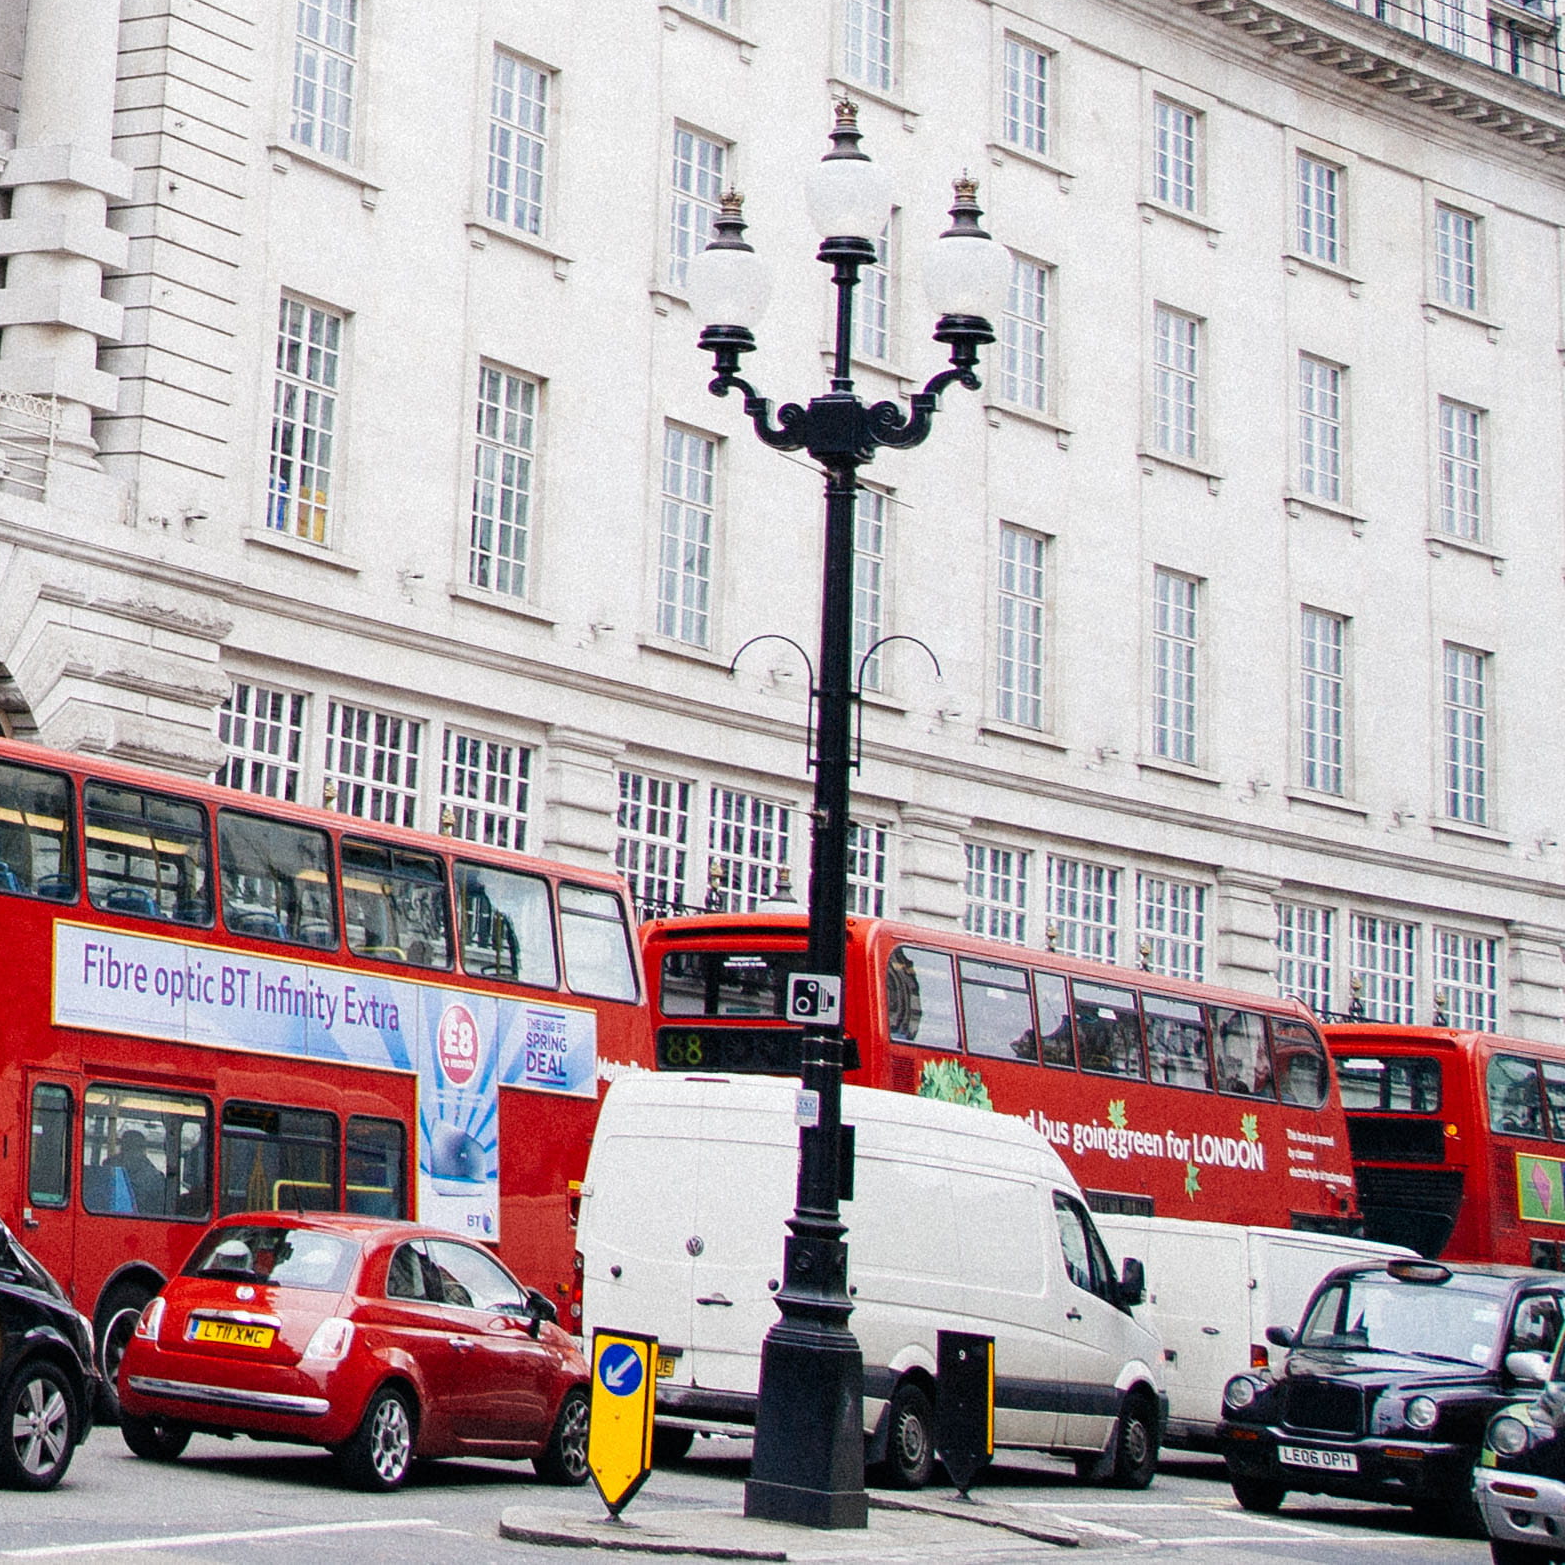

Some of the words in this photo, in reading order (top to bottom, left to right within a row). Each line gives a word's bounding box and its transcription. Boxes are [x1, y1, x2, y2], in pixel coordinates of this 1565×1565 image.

[84, 943, 148, 993] Fibre
[154, 961, 214, 1007] optic
[221, 966, 251, 1008] BT
[256, 971, 338, 1030] Infinity
[344, 985, 399, 1031] Extra
[526, 1017, 541, 1030] THE
[542, 1019, 556, 1032] BIG
[443, 1020, 474, 1057] £8
[526, 1033, 567, 1053] SPRING
[667, 1034, 703, 1065] 88
[526, 1051, 567, 1077] DEAL
[1038, 1110, 1070, 1145] bus
[1073, 1118, 1119, 1158] going
[1118, 1126, 1163, 1159] green
[1166, 1130, 1191, 1161] for
[1192, 1132, 1265, 1171] LONDON
[467, 1214, 480, 1227] BT
[204, 1323, 232, 1340] LT11
[234, 1327, 265, 1344] XMC
[1283, 1447, 1319, 1465] LE06
[1321, 1452, 1351, 1467] OPH
